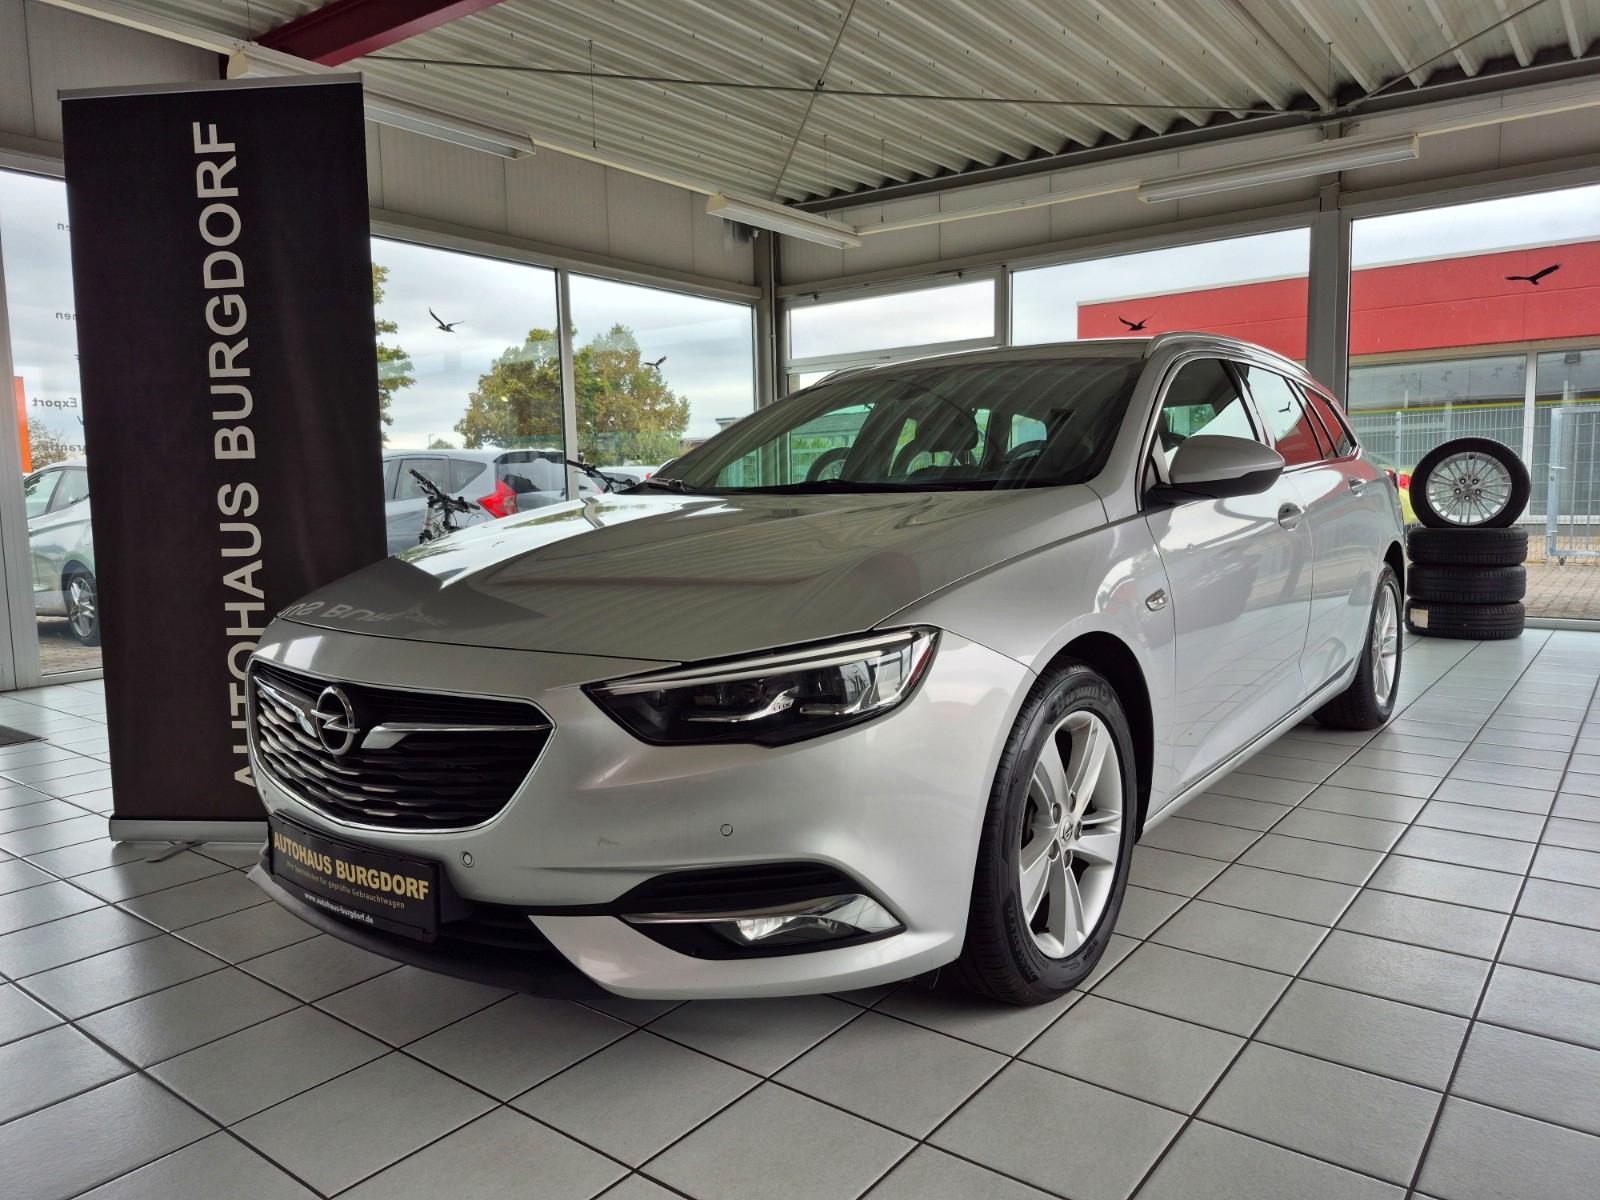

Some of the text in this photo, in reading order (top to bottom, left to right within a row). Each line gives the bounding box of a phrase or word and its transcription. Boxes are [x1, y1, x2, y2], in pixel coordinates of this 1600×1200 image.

[192, 121, 256, 460] BURGDORF
[273, 831, 334, 876] AUTOHAUS
[335, 858, 429, 901] BURGDORF
[304, 891, 374, 925] www.autohaus-burgdorf.de
[352, 887, 405, 910] Gebrauchtwagen
